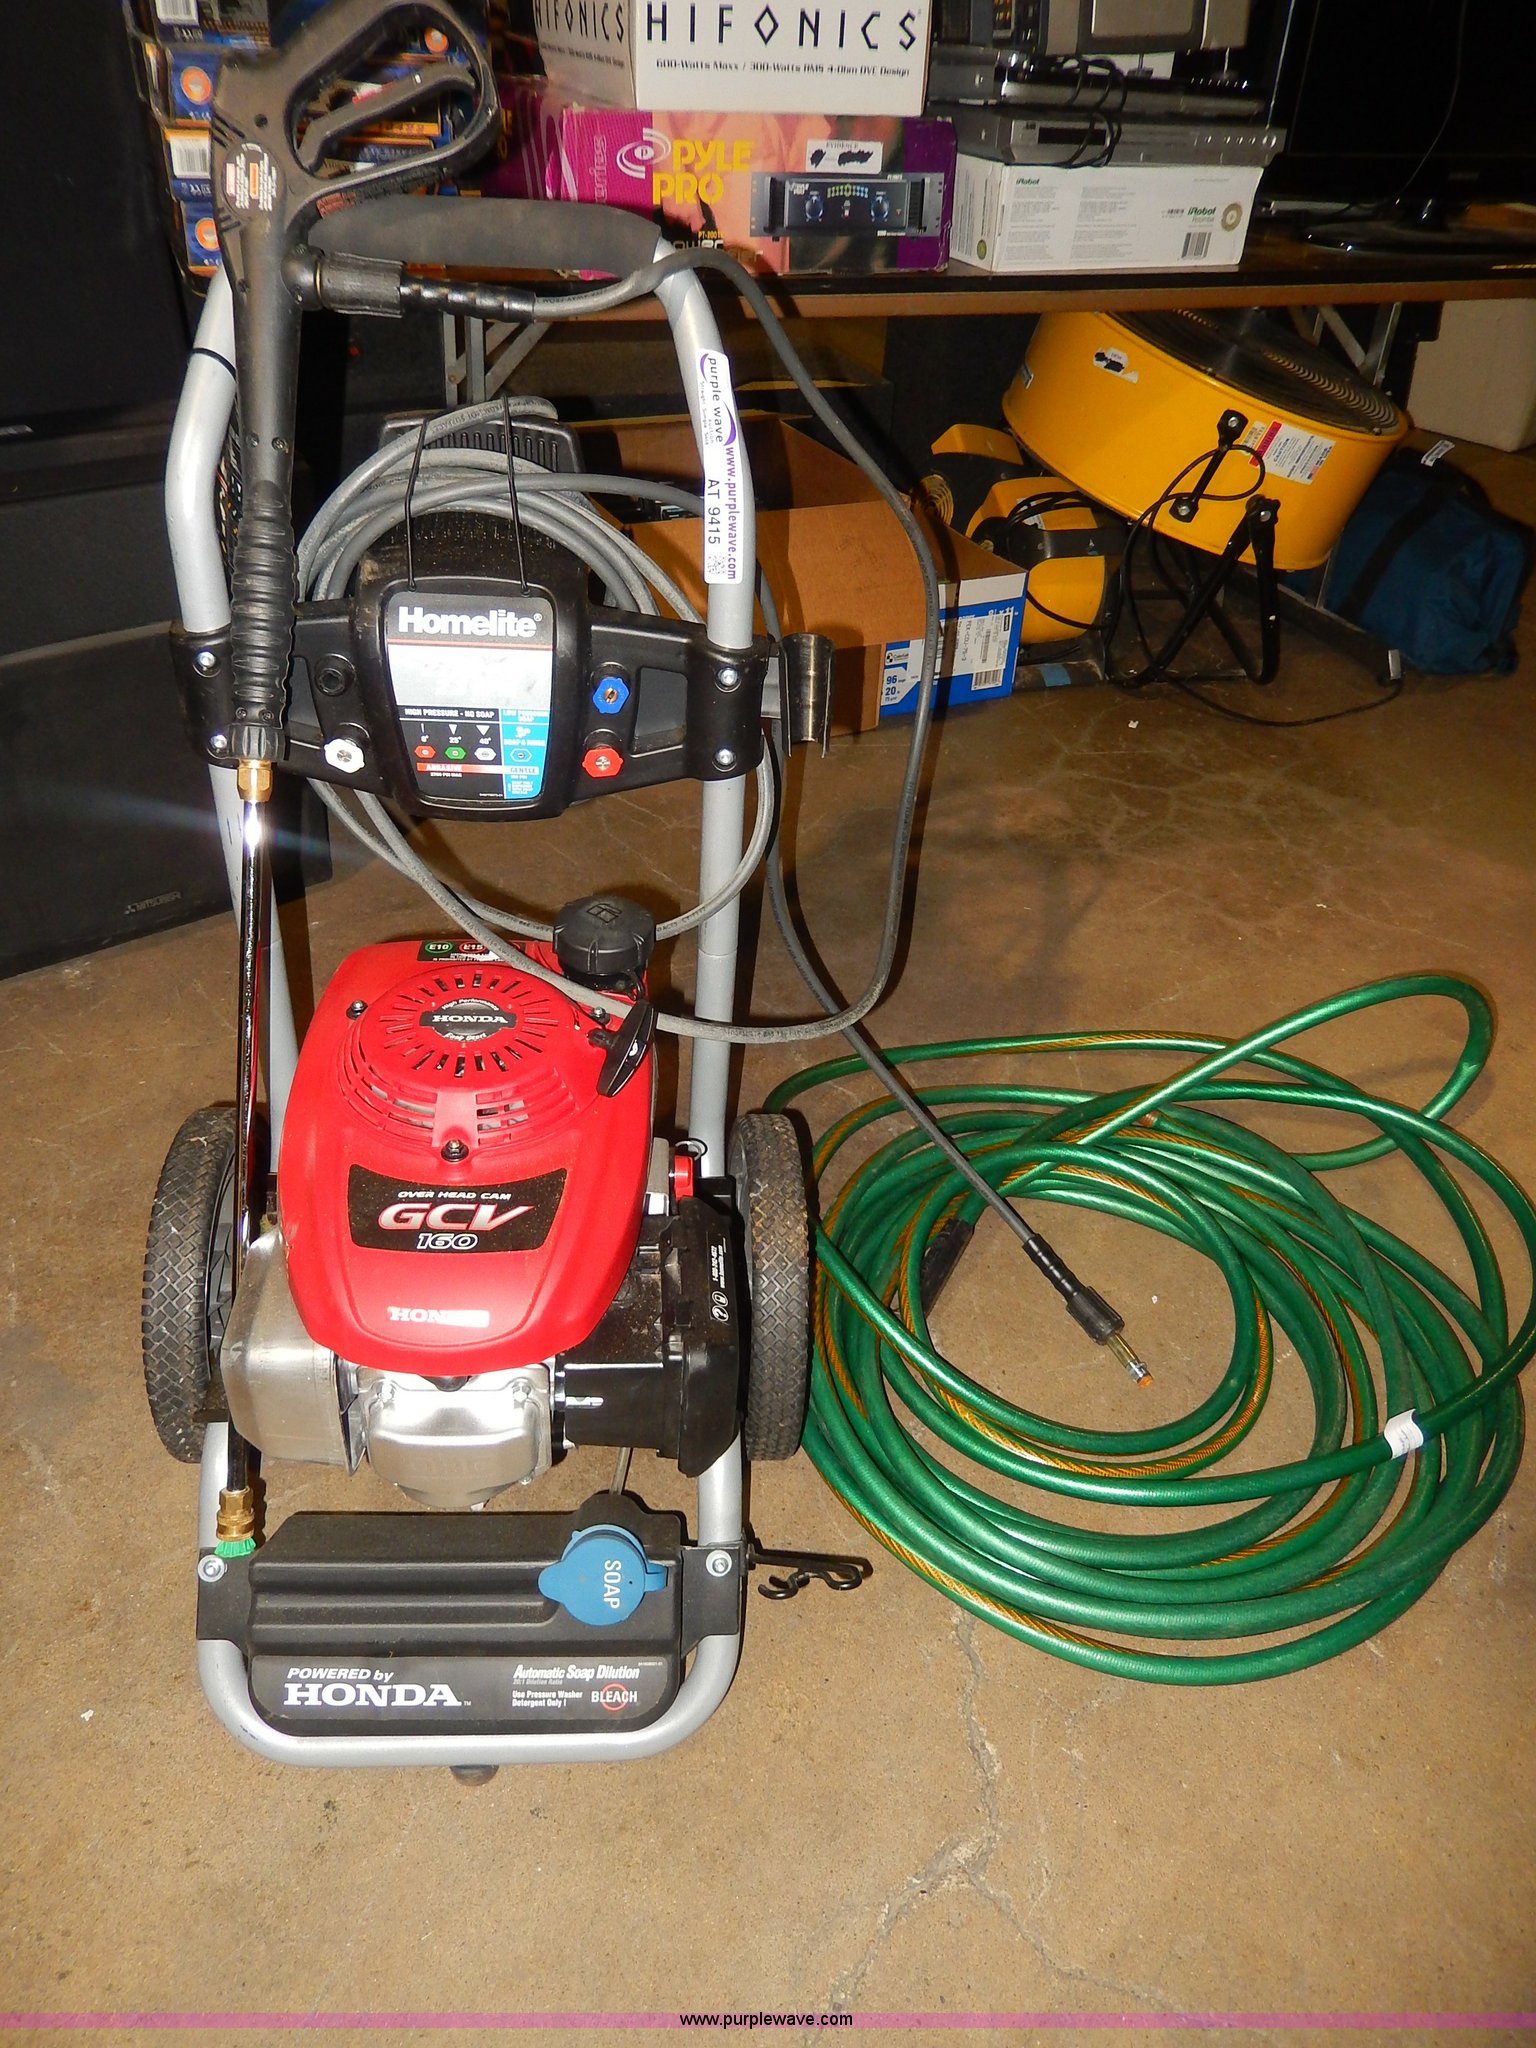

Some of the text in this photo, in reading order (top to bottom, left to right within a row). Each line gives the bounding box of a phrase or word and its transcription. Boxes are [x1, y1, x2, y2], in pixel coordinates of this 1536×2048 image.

[647, 1, 917, 51] HIFONICS
[656, 58, 710, 70] 600-Watts
[713, 60, 739, 71] Maxx
[880, 66, 910, 78] Design
[672, 139, 755, 173] PYLE
[652, 172, 725, 206] PRO
[1015, 178, 1040, 186] iRobot
[1187, 207, 1217, 216] iRobot
[707, 357, 724, 444] purple wave
[707, 478, 721, 546] AT 9415
[725, 446, 741, 581] www.purplewave.com
[398, 606, 538, 638] Homelite
[886, 675, 898, 685] 96
[884, 686, 897, 696] 20
[404, 708, 423, 716] HIGH
[423, 709, 459, 717] PRESSURE
[465, 710, 475, 718] NO
[475, 711, 495, 719] SOAP
[441, 998, 500, 1011] High Performance
[432, 1014, 508, 1024] HONDA
[398, 1190, 512, 1201] OVER HEAD CAM
[378, 1202, 536, 1232] GCV
[416, 1232, 478, 1250] 160
[603, 1559, 622, 1609] SOAP
[287, 1667, 394, 1684] POWERED by
[512, 1664, 641, 1682] Automatic Soap Dilution
[283, 1682, 462, 1707] HONDA
[512, 1690, 583, 1699] Use Pressure Washer
[512, 1698, 546, 1708] Detergent
[546, 1699, 562, 1709] Only
[591, 1690, 638, 1703] BLEACH
